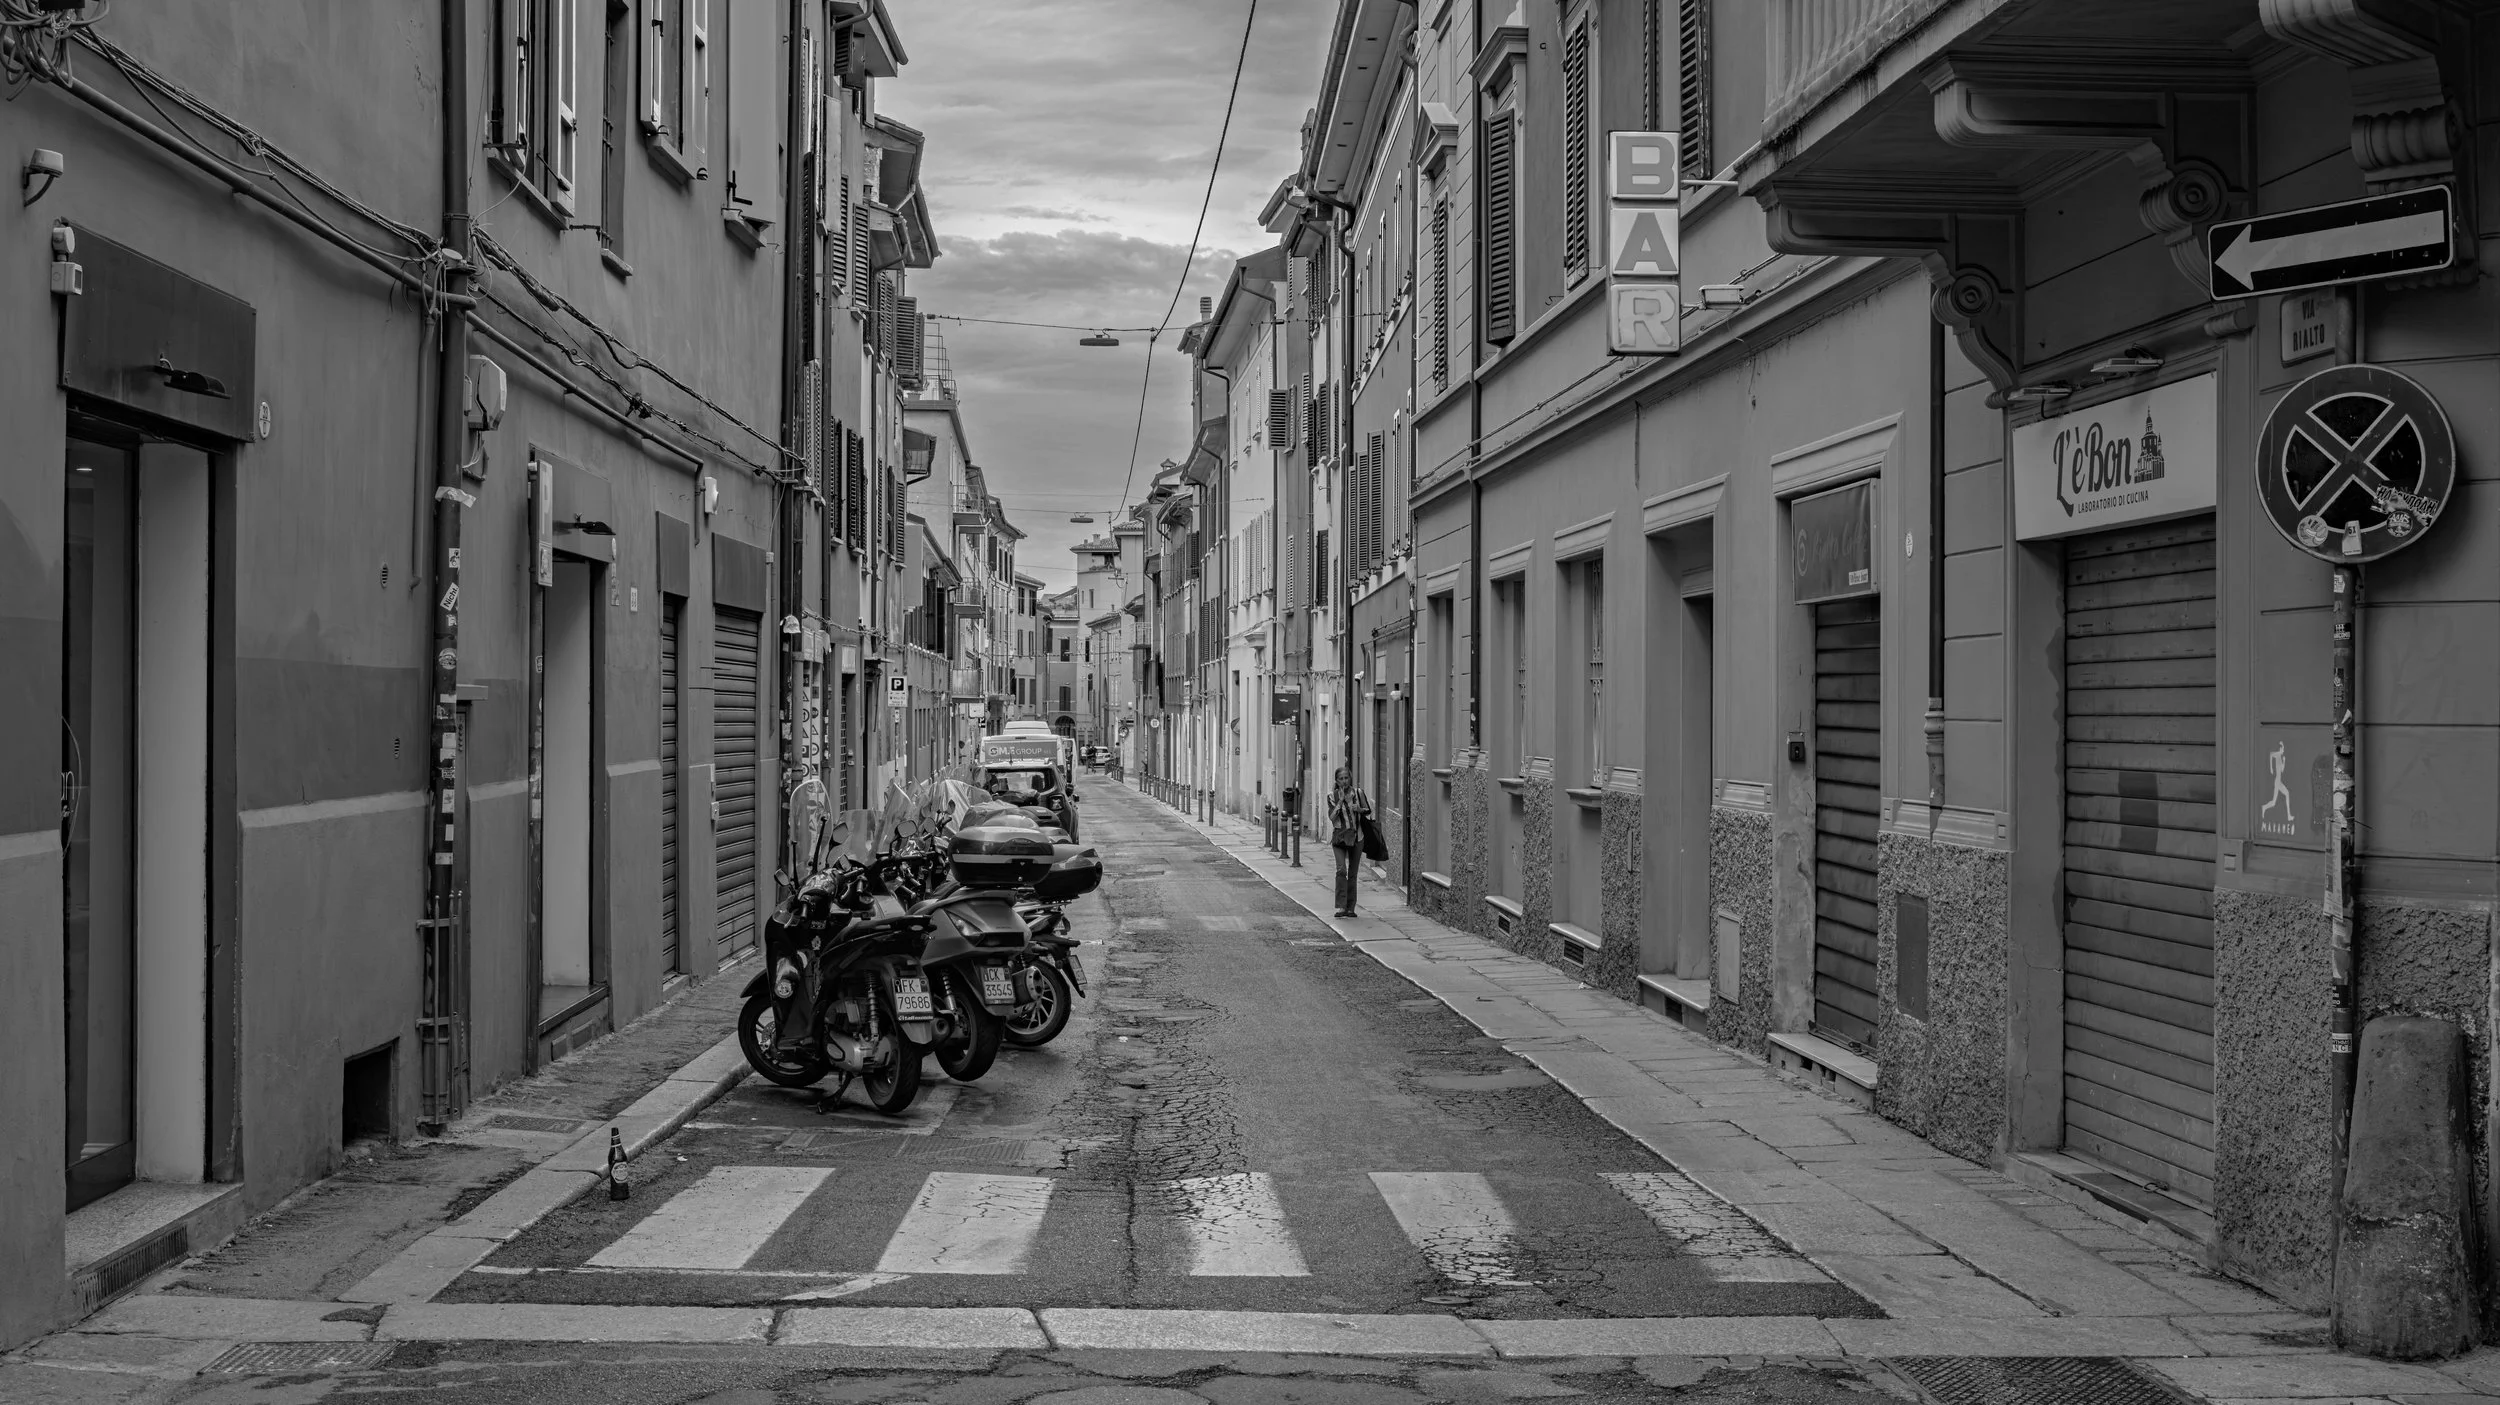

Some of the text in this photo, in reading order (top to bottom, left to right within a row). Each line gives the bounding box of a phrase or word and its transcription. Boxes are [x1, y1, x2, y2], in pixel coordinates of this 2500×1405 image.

[1615, 135, 1677, 348] BAR
[2302, 298, 2315, 320] VIA
[2293, 323, 2325, 352] RIALTO
[2078, 490, 2149, 514] LABORATORIO DI CUCINA
[893, 679, 902, 689] P
[1016, 747, 1042, 755] GROUP
[988, 968, 1000, 981] CK
[901, 979, 915, 992] FK
[985, 983, 1013, 996] 33545
[897, 995, 930, 1010] 79686
